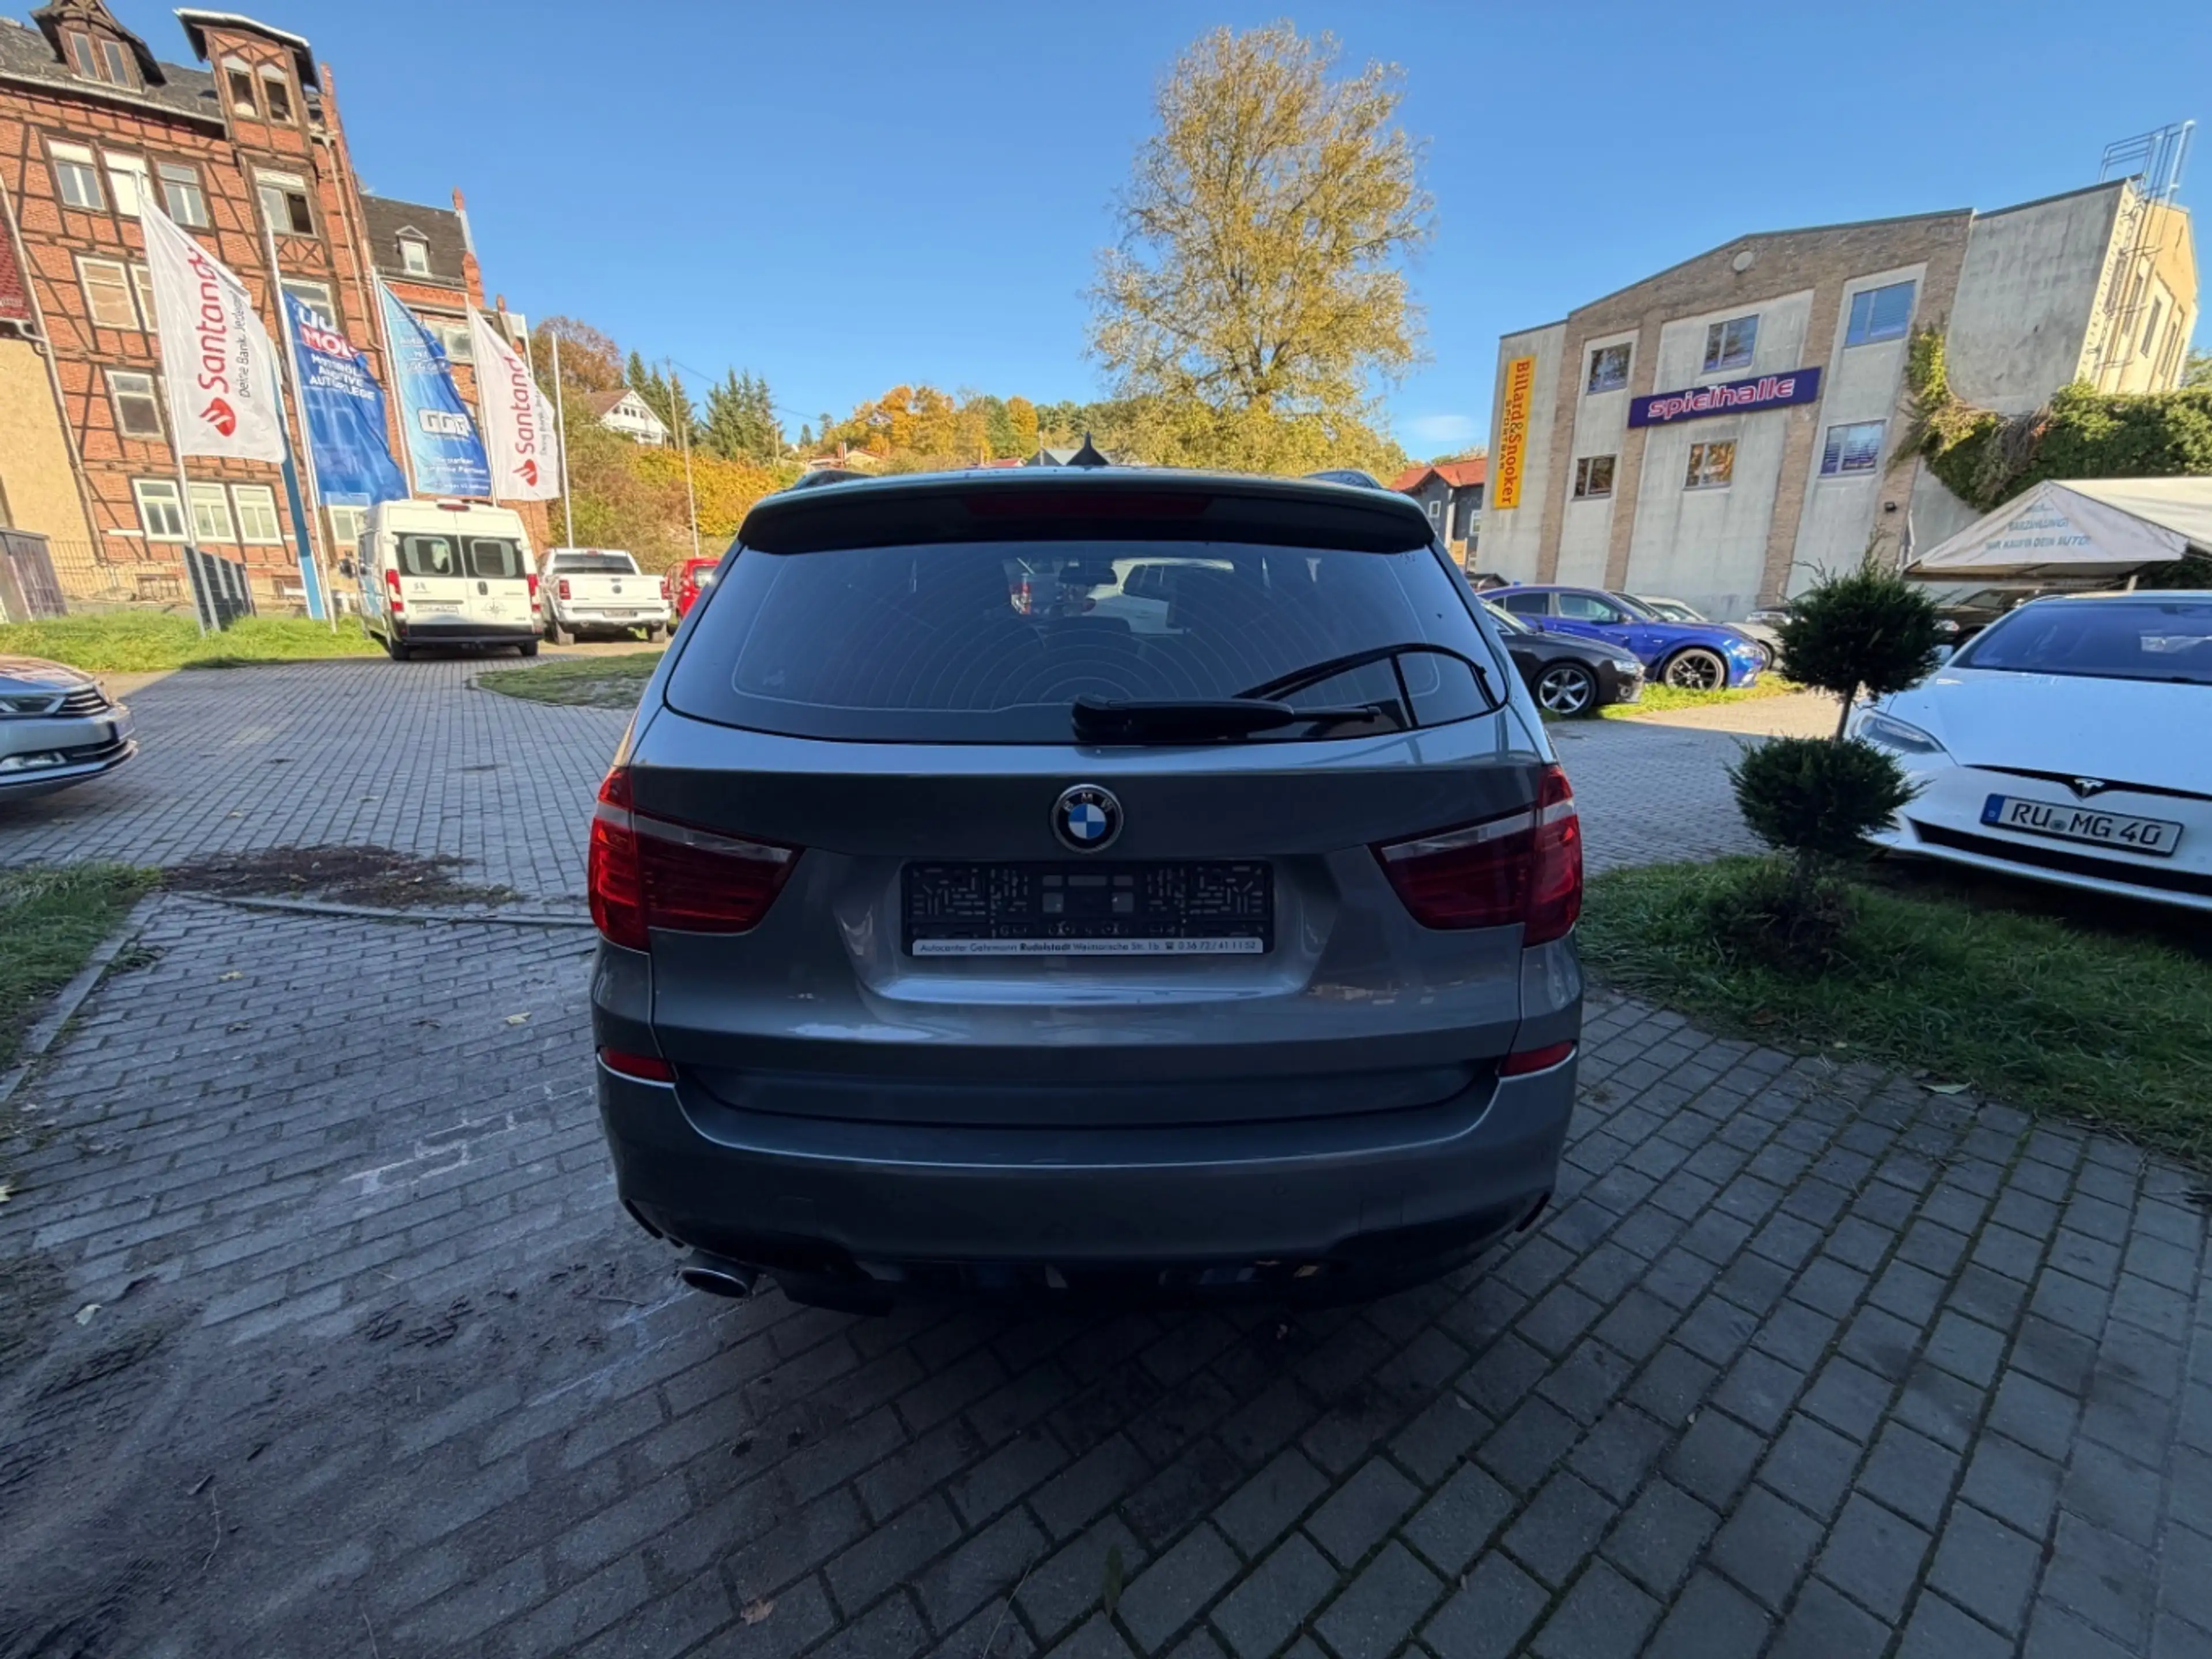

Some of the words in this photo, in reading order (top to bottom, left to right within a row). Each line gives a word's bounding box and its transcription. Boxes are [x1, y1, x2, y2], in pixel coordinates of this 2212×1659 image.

[1648, 376, 1795, 420] spielhalle
[2011, 802, 2053, 827] RU
[2069, 813, 2113, 838] MG
[2119, 822, 2162, 846] 40
